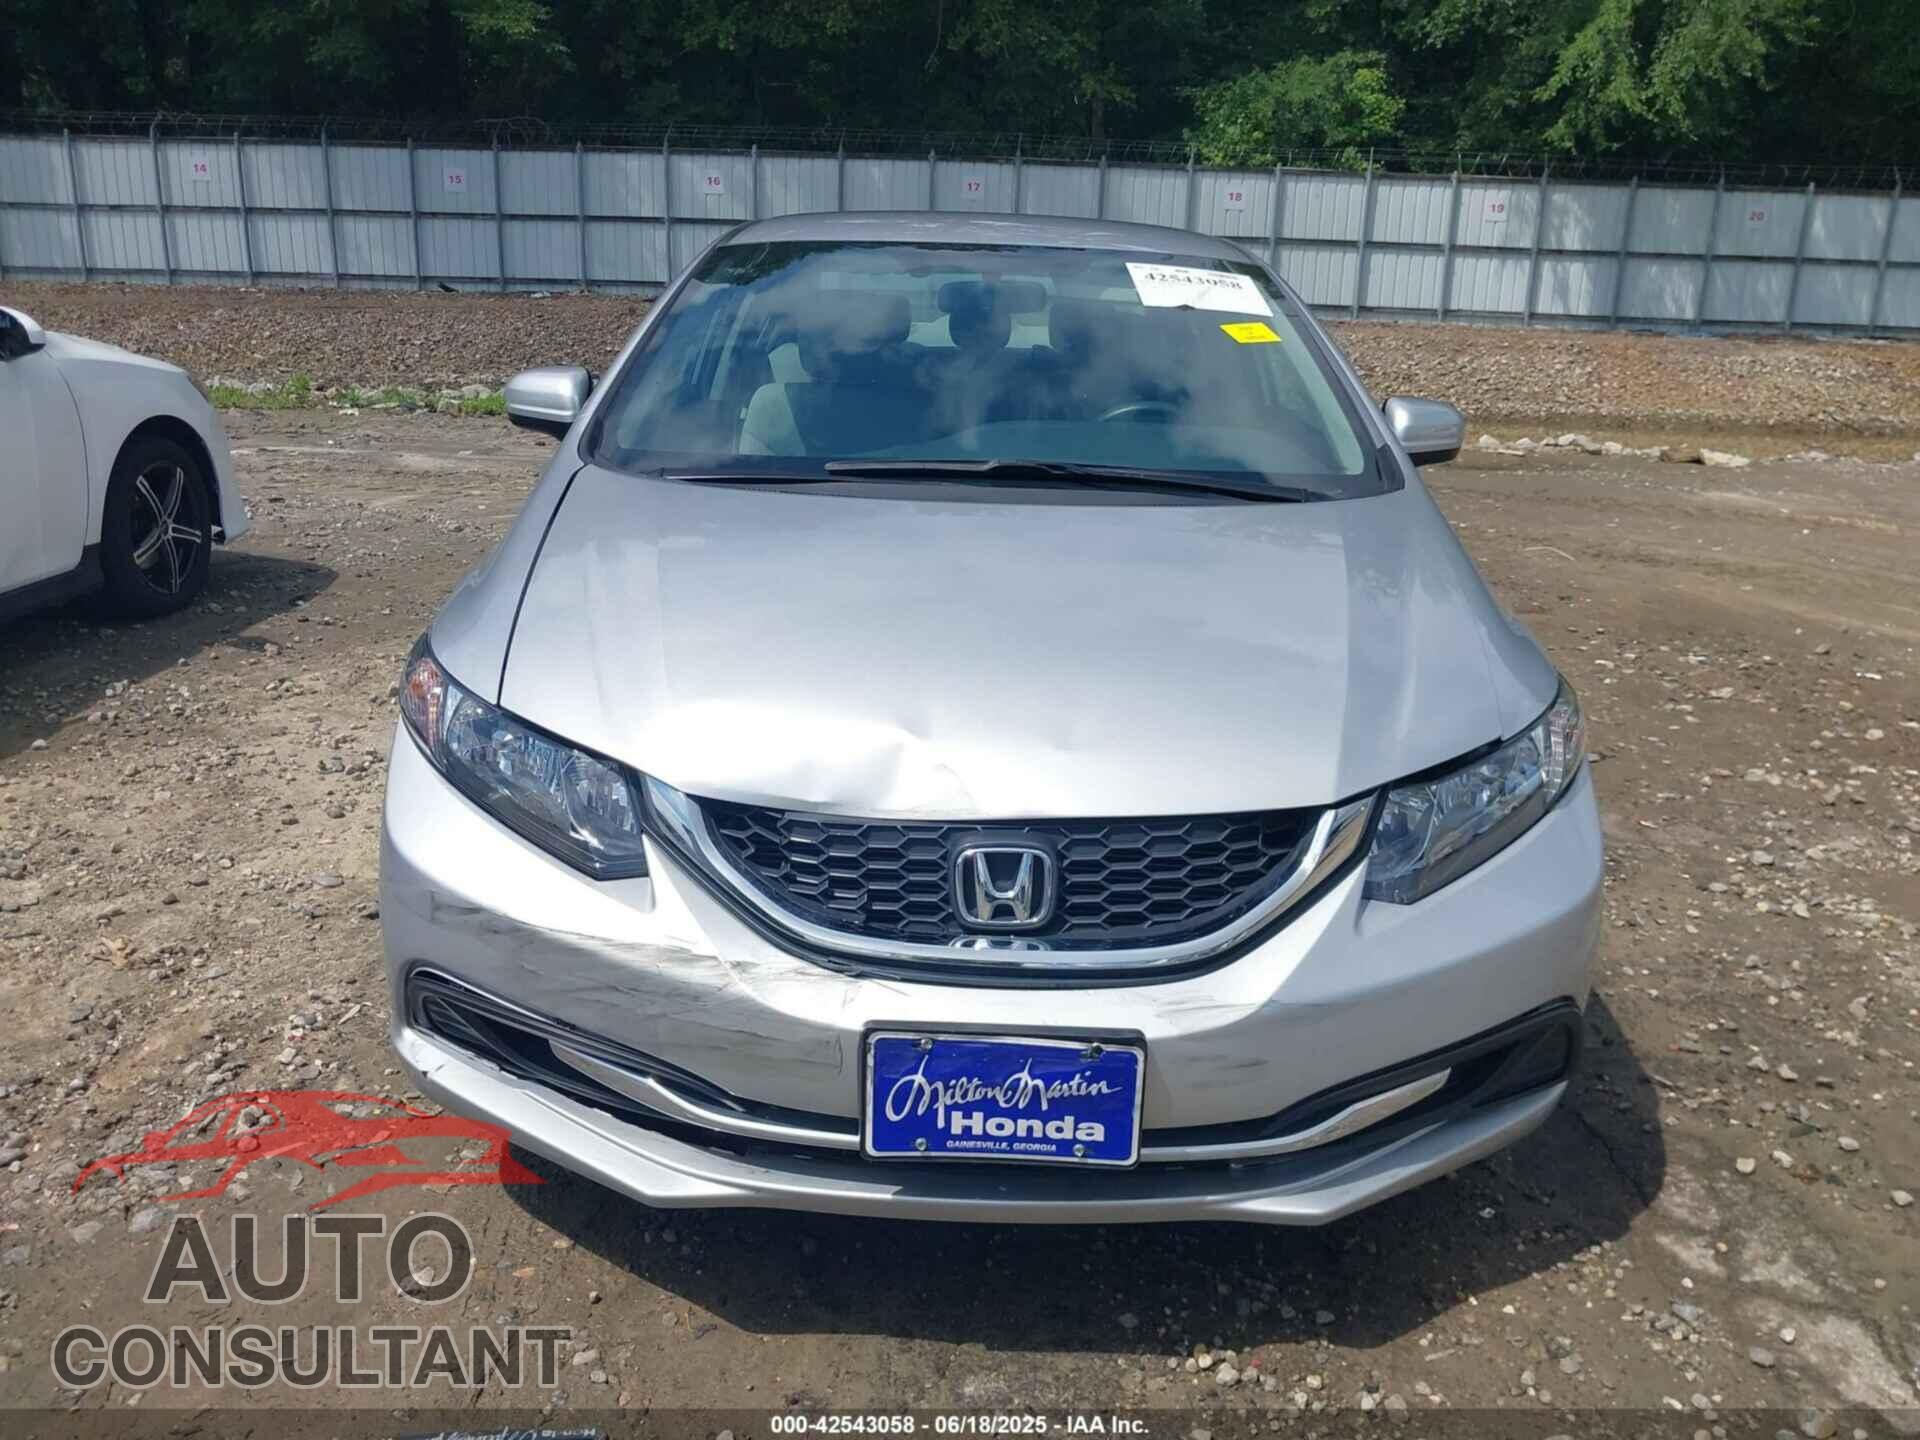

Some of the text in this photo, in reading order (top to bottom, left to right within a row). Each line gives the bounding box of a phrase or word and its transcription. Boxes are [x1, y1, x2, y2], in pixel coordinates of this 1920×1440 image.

[193, 164, 207, 173] 14
[449, 175, 463, 184] 15
[707, 176, 721, 186] 16
[968, 182, 981, 192] 17
[1228, 192, 1242, 202] 18
[1491, 204, 1505, 213] 19
[1749, 211, 1765, 221] 20
[885, 1054, 1123, 1129] Milton Martin
[950, 1110, 1105, 1142] Honda
[946, 1140, 1057, 1152] GAINESVILLE, GEORGIA
